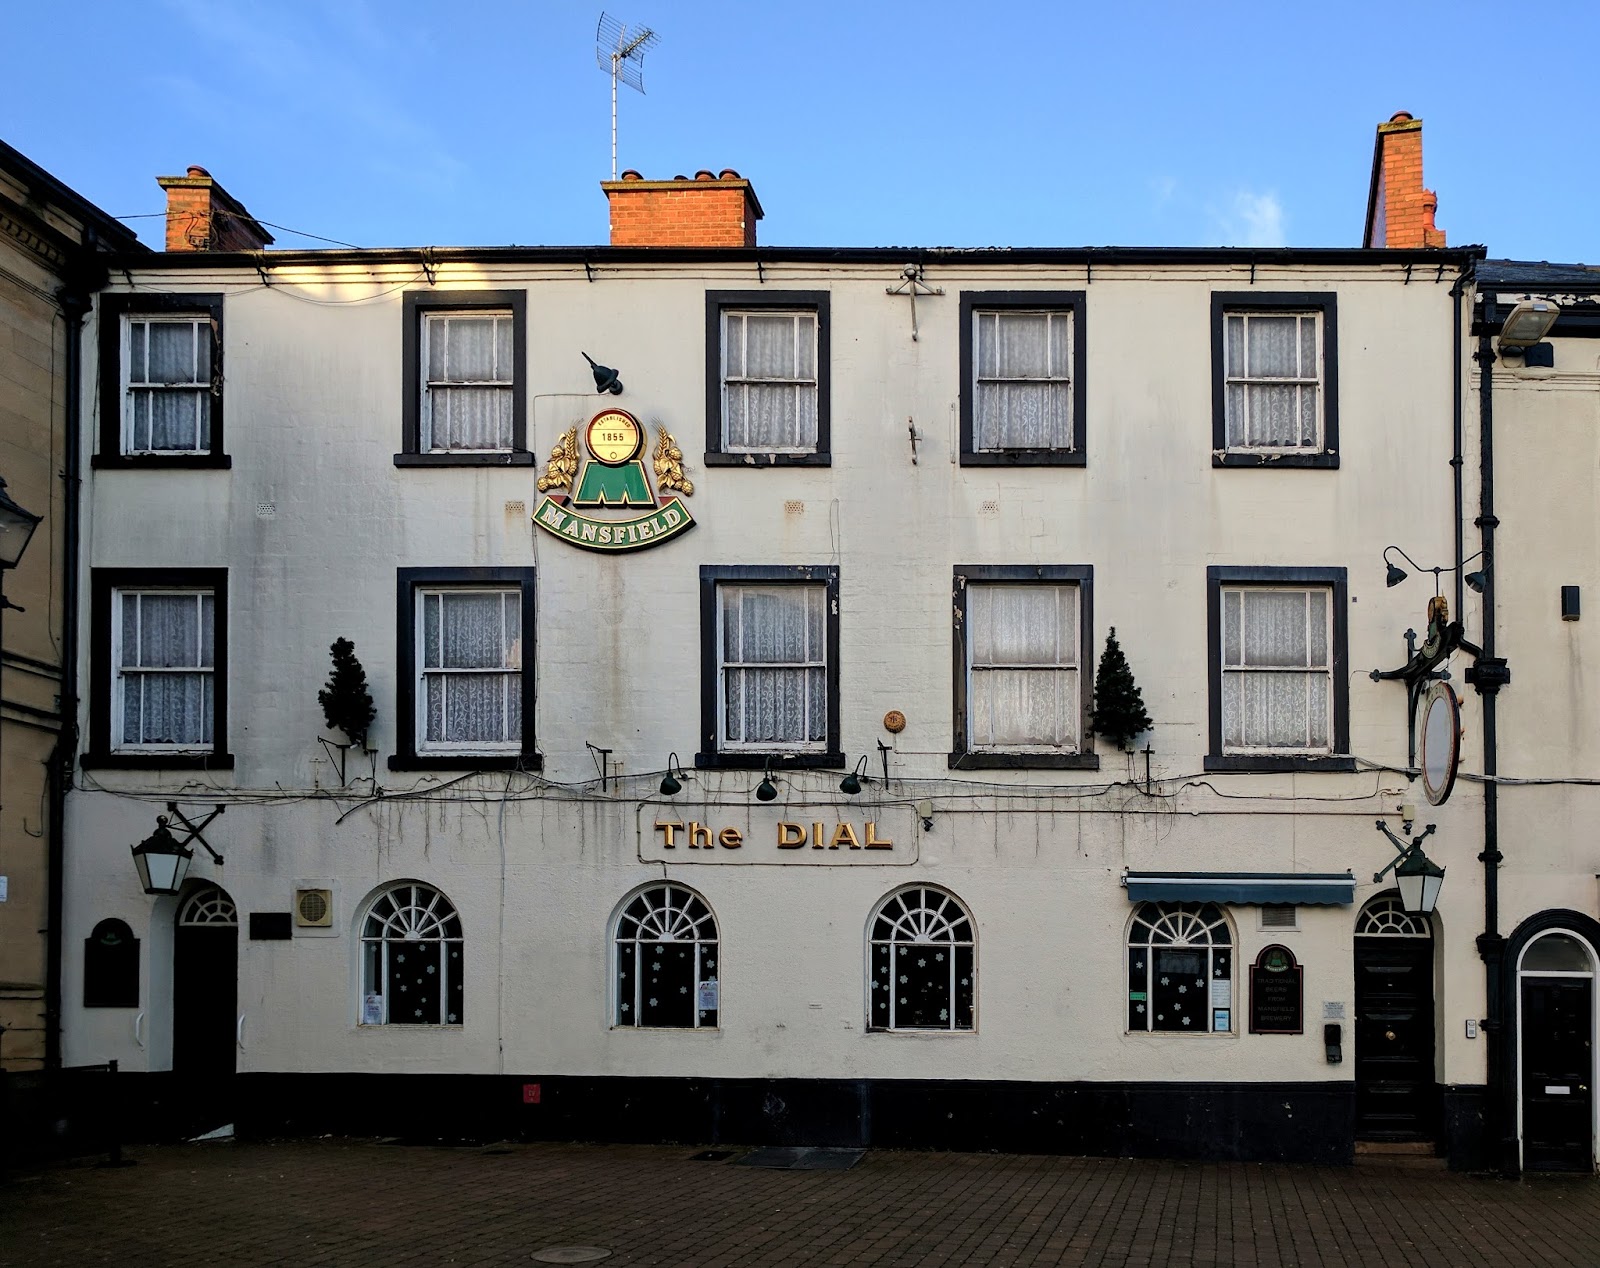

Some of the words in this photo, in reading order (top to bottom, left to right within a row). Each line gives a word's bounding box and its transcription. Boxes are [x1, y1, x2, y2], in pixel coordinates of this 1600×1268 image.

[598, 415, 631, 428] ESTABLISHED
[602, 433, 624, 442] 1855
[540, 505, 681, 544] MANSFIELD
[655, 821, 743, 849] The
[777, 821, 893, 850] DIAL
